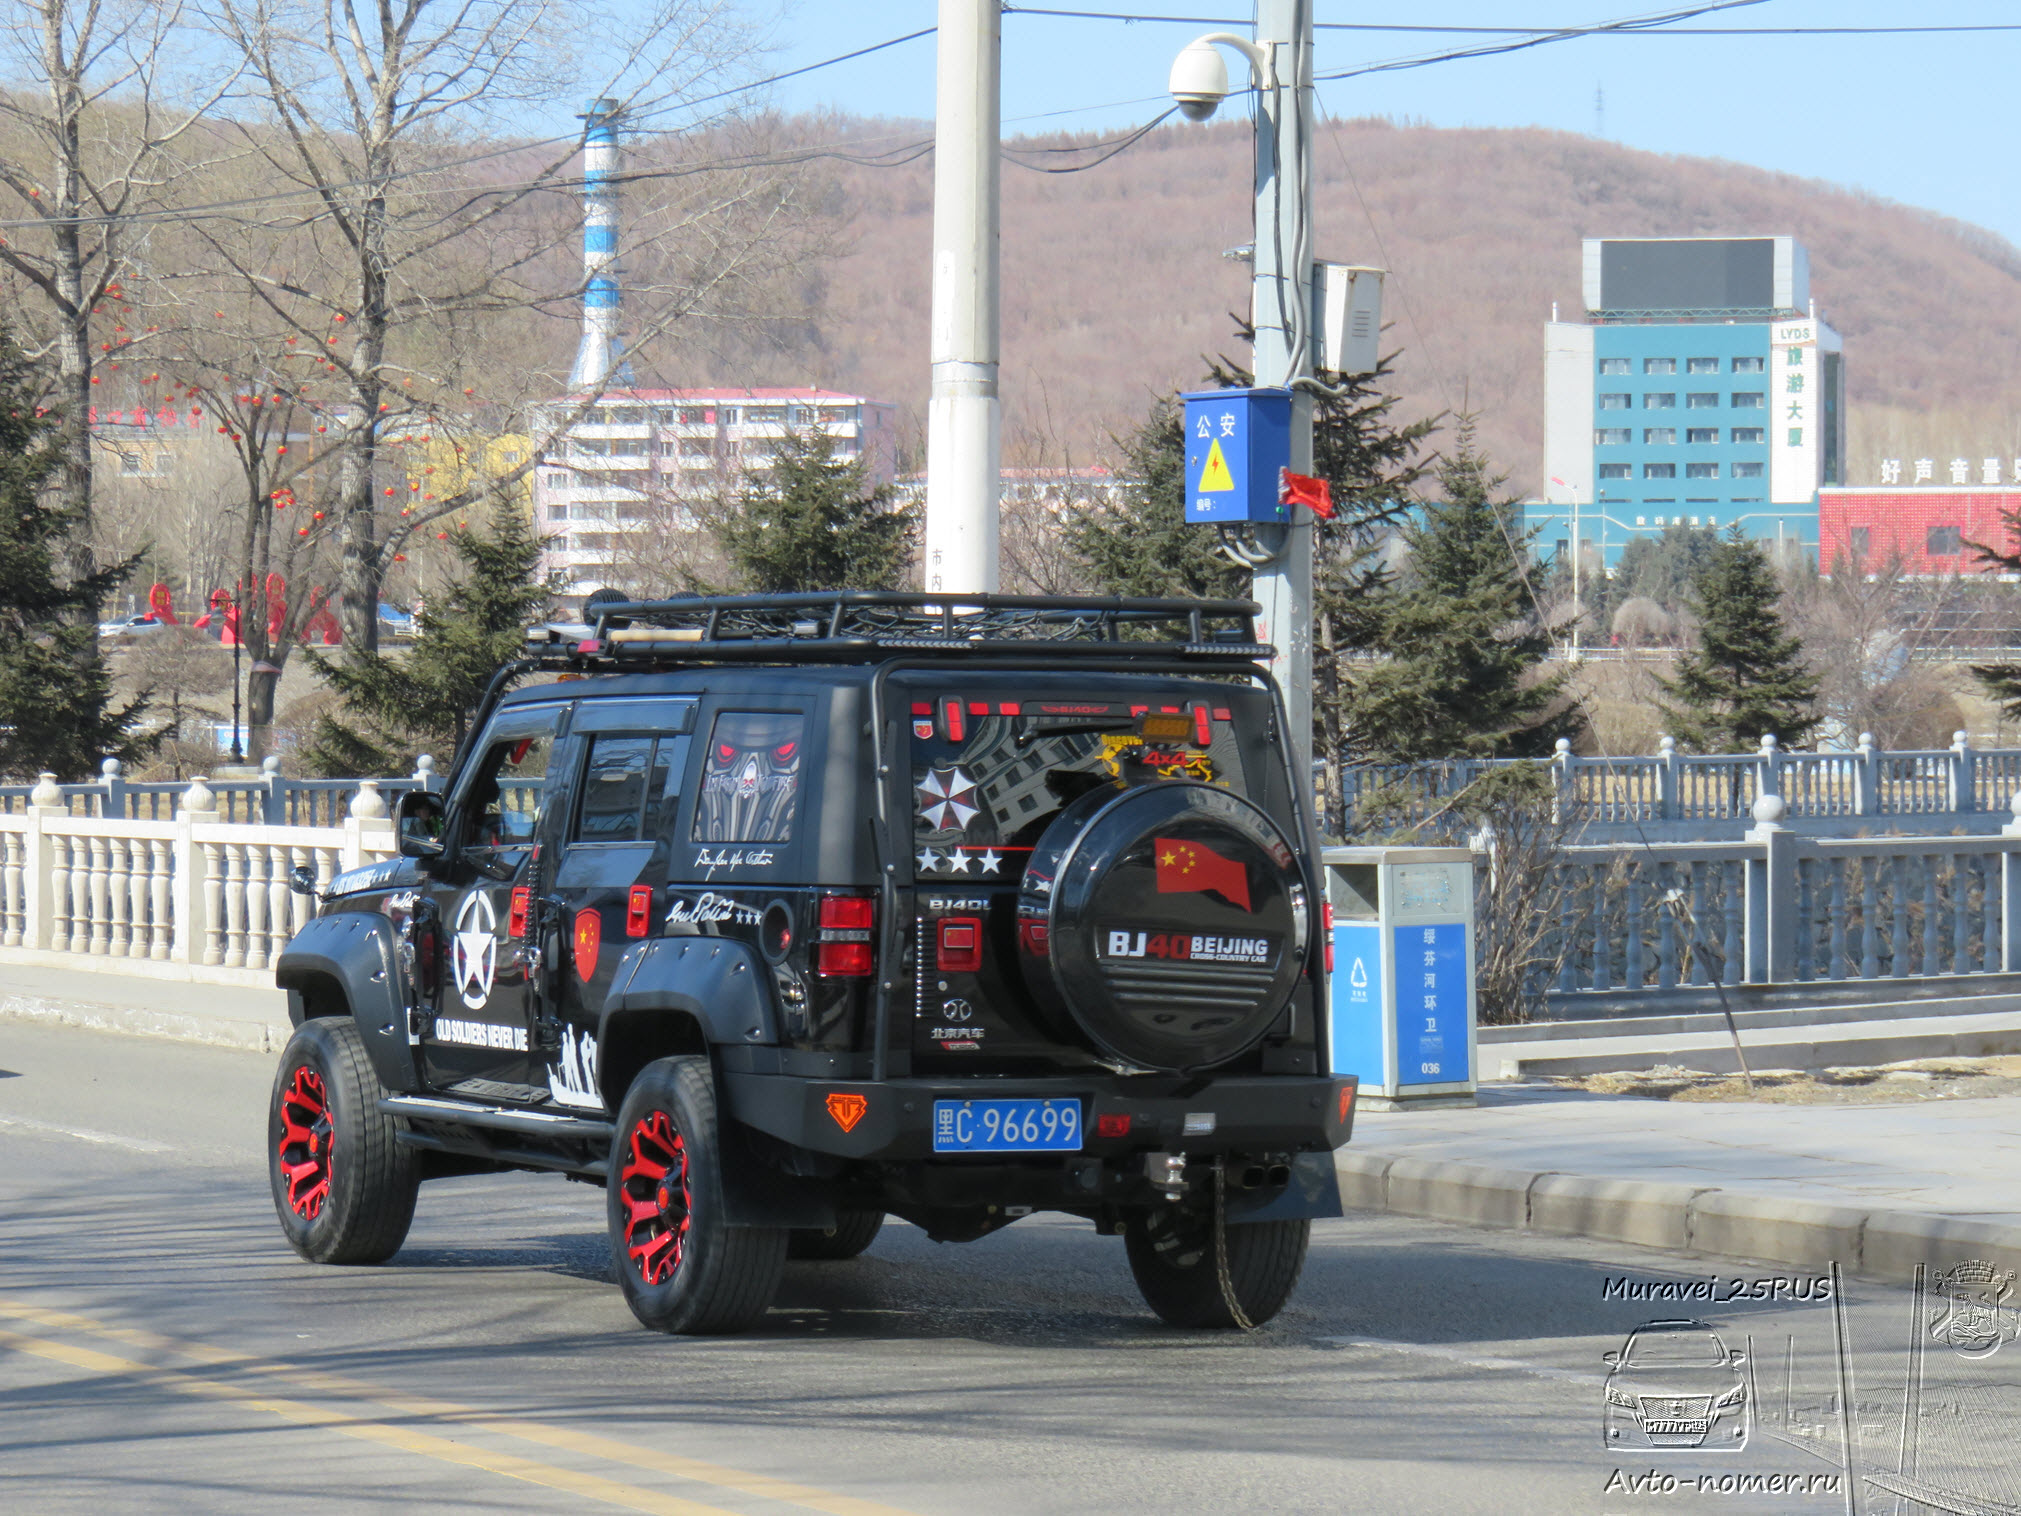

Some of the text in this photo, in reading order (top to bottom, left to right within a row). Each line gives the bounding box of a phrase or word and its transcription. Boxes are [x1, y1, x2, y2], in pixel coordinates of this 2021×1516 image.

[1781, 328, 1810, 339] LYDS
[1786, 346, 1804, 447] 旅游大厦
[1197, 413, 1235, 438] 公安
[1143, 751, 1189, 766] 4x4
[1108, 931, 1268, 960] BJ40 BEIJING
[1250, 955, 1267, 963] CAR
[1423, 928, 1437, 1033] 绥芬河环卫
[436, 1018, 529, 1052] OLD SOLDIERS NEVER DIE
[931, 1027, 984, 1039] 北京汽车
[1421, 1062, 1441, 1074] 036
